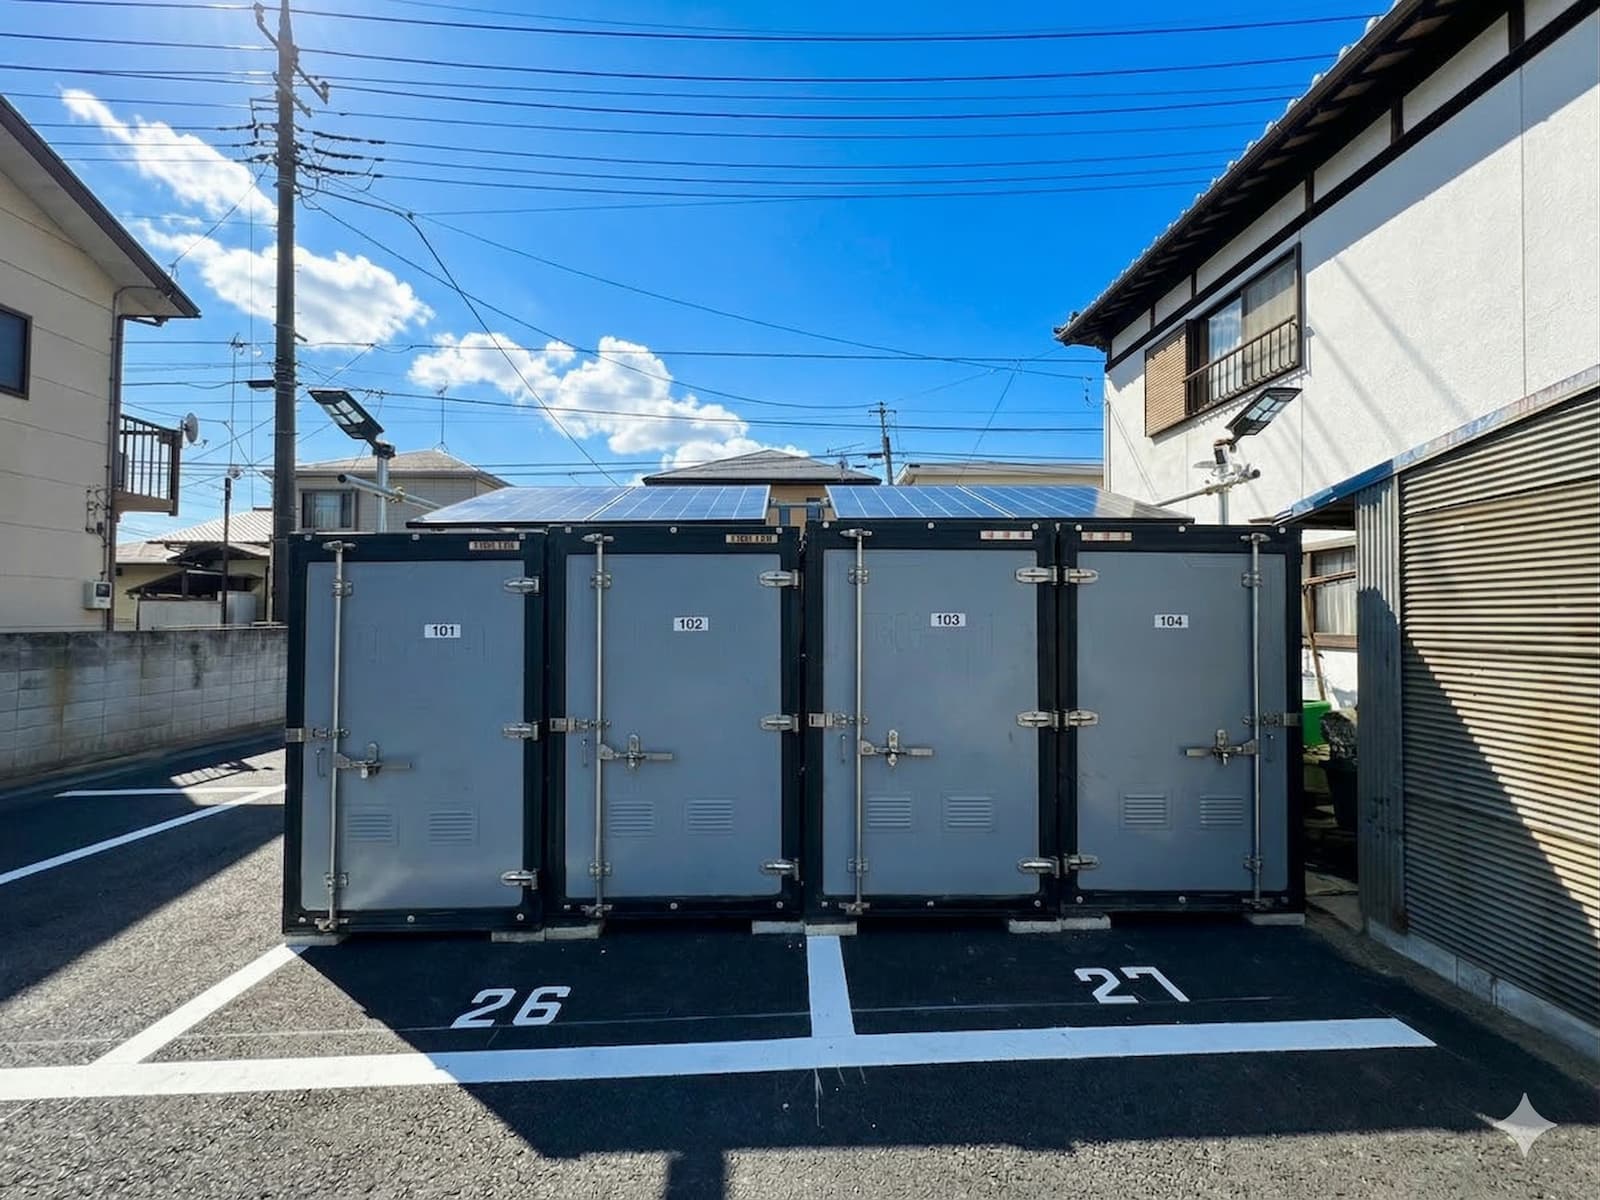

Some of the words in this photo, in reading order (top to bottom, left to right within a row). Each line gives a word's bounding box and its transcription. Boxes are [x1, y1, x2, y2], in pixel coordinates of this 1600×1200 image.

[679, 618, 703, 630] 102
[936, 614, 960, 626] 103
[1160, 615, 1183, 627] 104
[432, 625, 455, 637] 101
[1074, 966, 1190, 1004] 27
[450, 986, 571, 1029] 26
